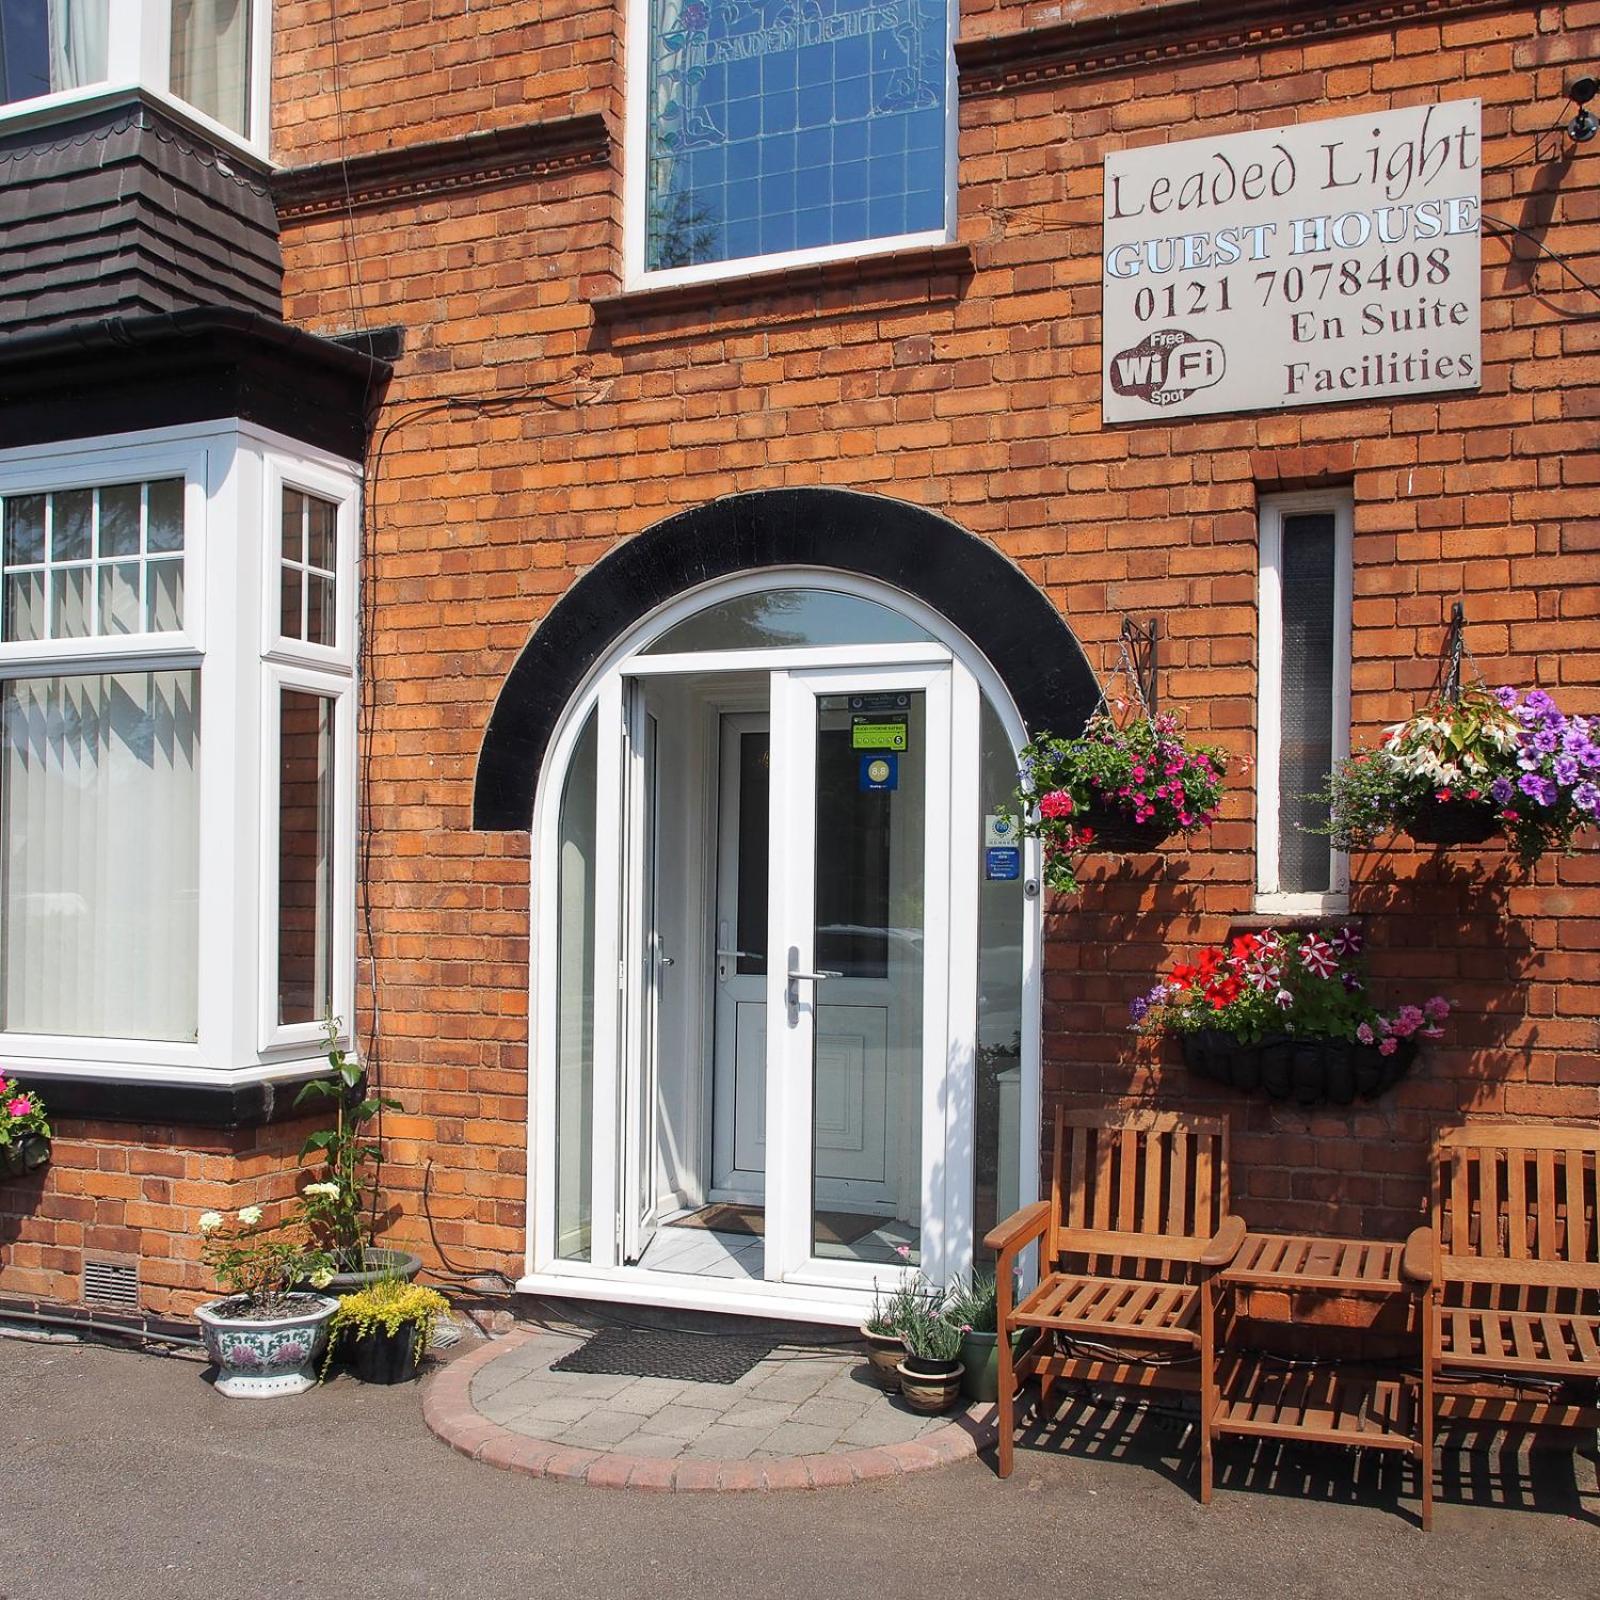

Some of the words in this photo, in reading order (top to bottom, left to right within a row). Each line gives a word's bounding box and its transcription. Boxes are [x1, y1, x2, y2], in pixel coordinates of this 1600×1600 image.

[1107, 144, 1297, 220] Leaded
[1320, 105, 1479, 201] Light
[1105, 223, 1277, 280] GUEST
[1288, 195, 1481, 257] HOUSE
[1134, 276, 1232, 322] 0121
[1255, 247, 1451, 307] 7078408
[1151, 332, 1185, 347] Free
[1290, 311, 1345, 343] En
[1361, 297, 1469, 336] Suite
[1283, 347, 1474, 395] Facilities
[1151, 389, 1185, 405] Spot
